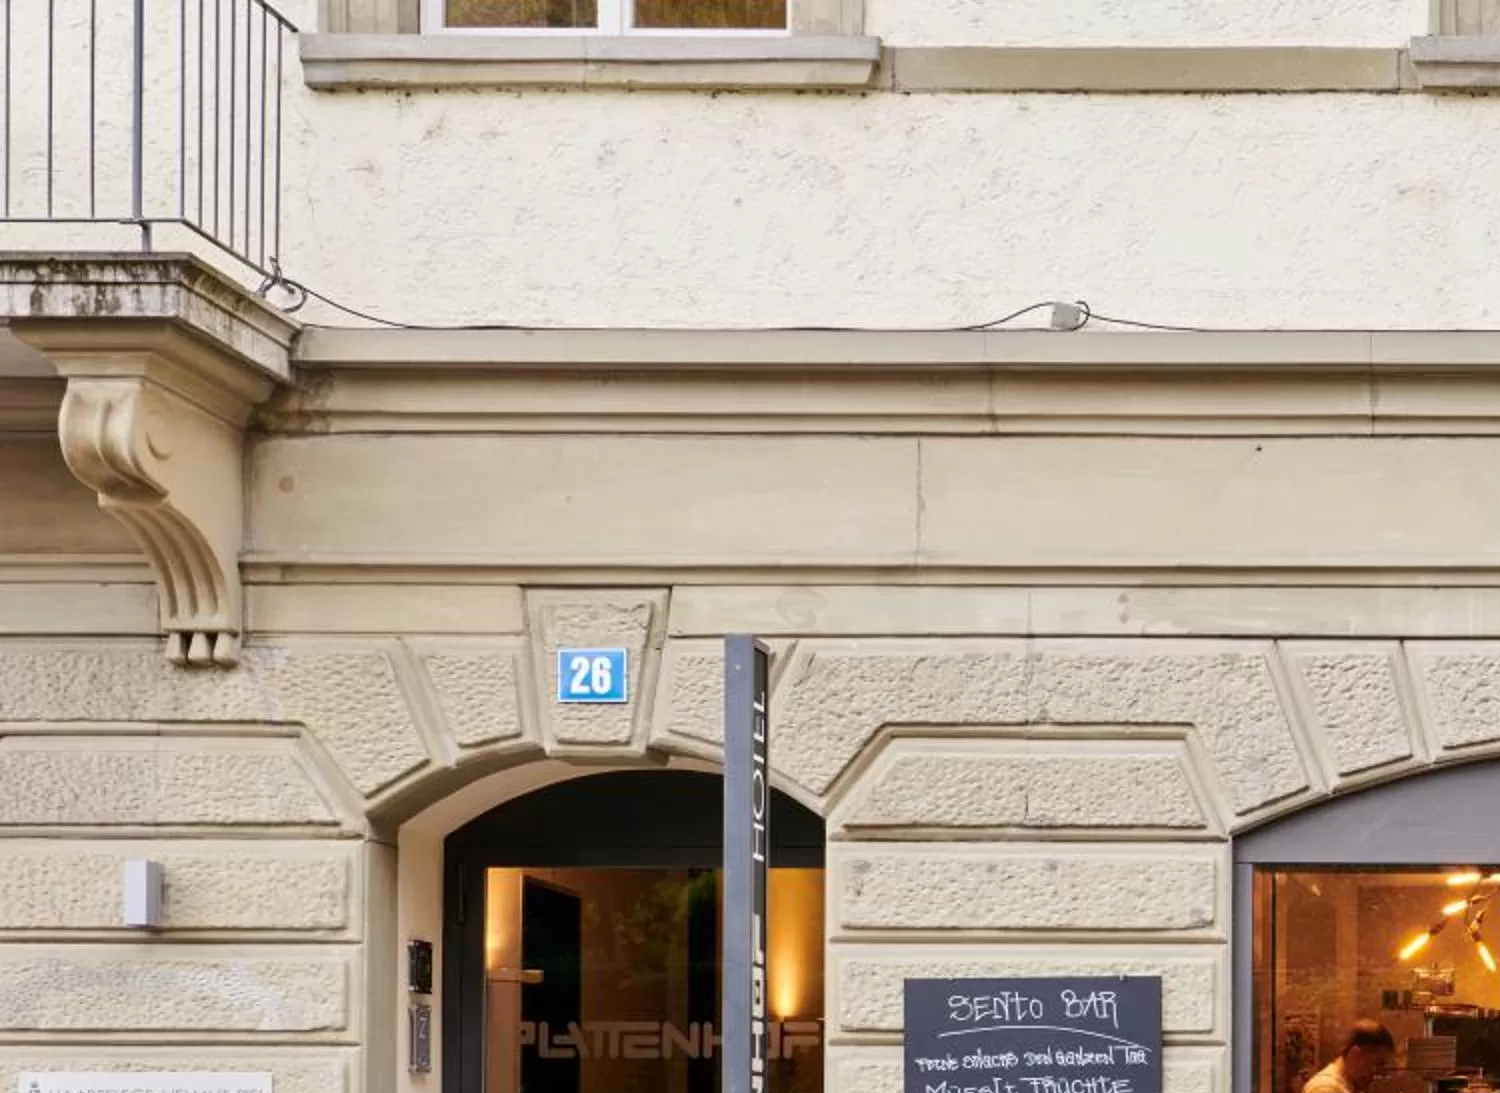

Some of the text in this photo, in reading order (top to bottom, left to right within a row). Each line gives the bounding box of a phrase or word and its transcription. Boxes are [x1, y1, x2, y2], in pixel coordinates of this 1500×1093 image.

[570, 655, 612, 695] 26
[752, 691, 765, 863] HOTEL
[947, 989, 1119, 1029] SENTO BAR
